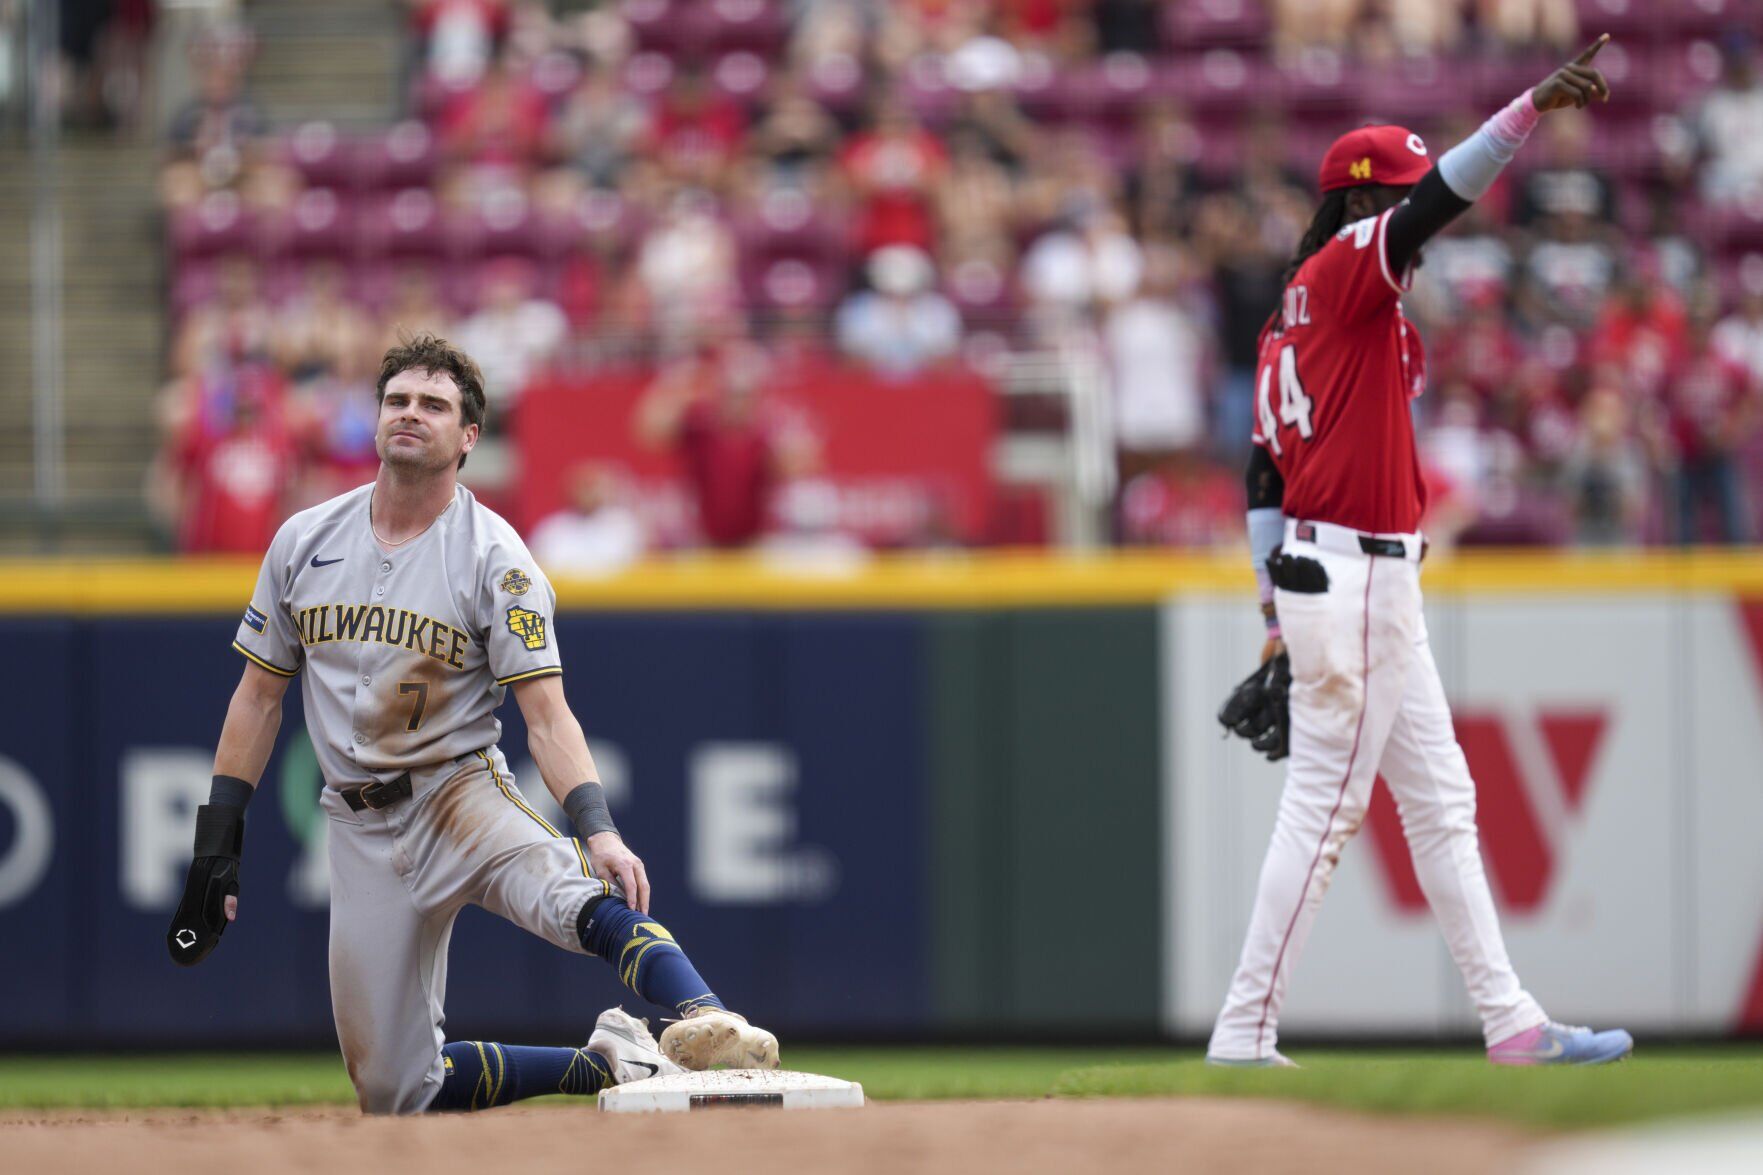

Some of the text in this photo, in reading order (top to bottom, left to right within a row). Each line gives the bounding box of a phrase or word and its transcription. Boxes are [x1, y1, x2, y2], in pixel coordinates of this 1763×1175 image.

[1349, 157, 1372, 180] 44
[1257, 344, 1314, 457] 44
[399, 681, 430, 733] 7
